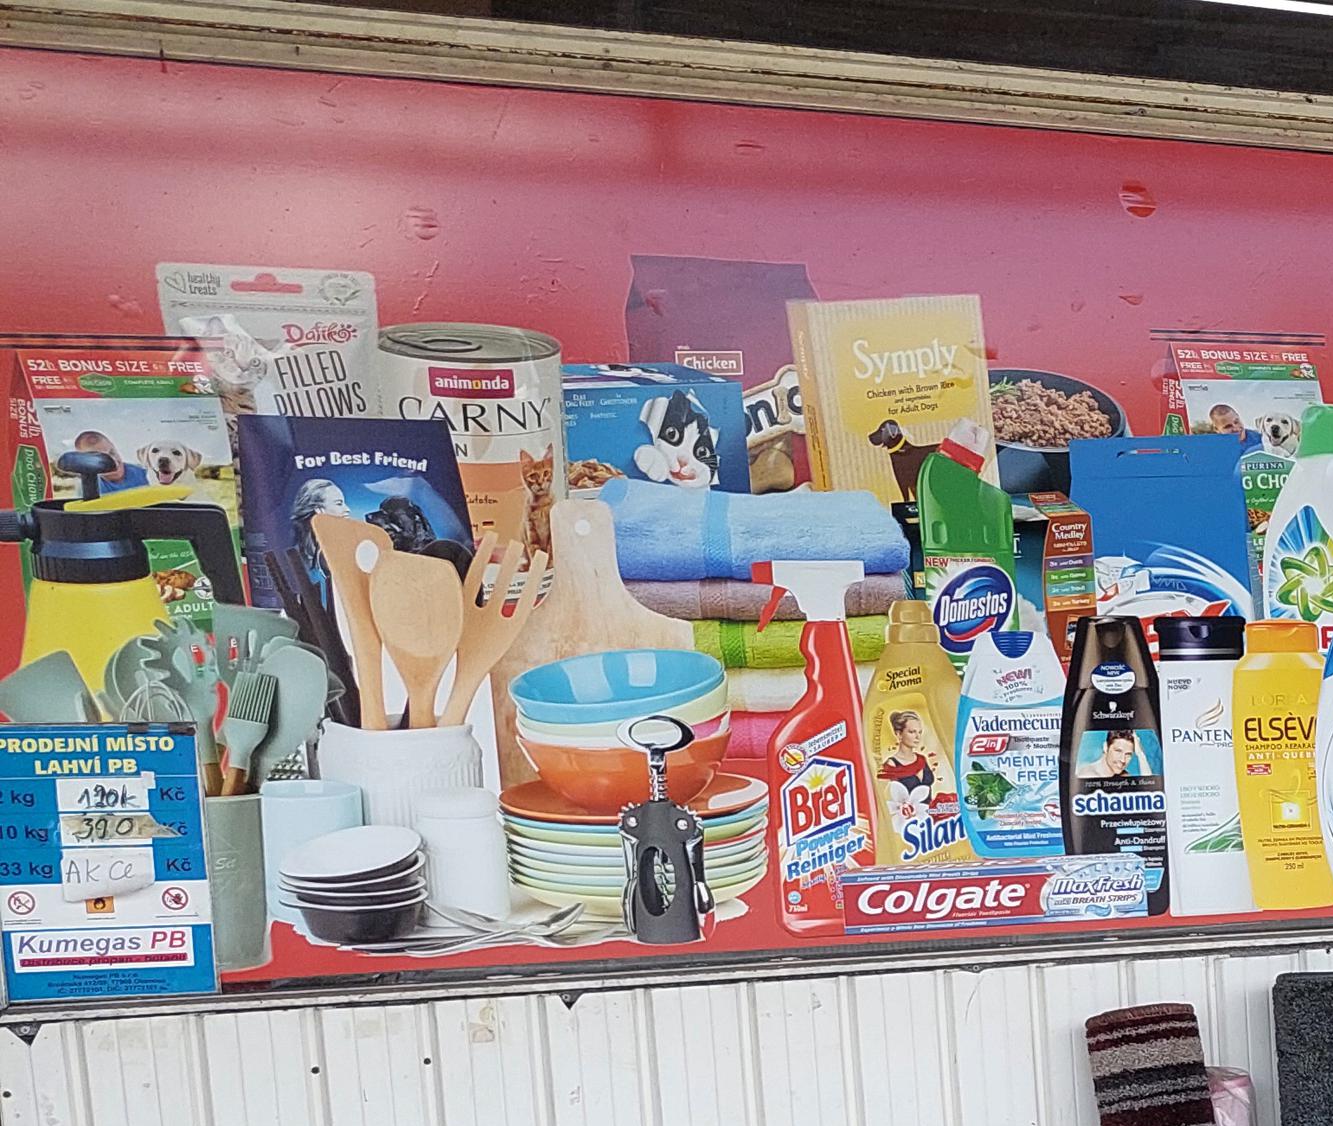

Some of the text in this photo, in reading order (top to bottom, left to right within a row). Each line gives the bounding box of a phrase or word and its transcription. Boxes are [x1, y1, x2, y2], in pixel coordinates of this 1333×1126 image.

[59, 360, 204, 373] BONUS SIZE FREE
[274, 350, 347, 390] FILLED
[683, 356, 738, 372] Chicken
[852, 337, 958, 385] Symply
[435, 370, 511, 391] animonda
[294, 451, 428, 473] For Best Friend
[1246, 461, 1284, 470] PURINA
[1051, 521, 1087, 534] Country
[1054, 530, 1085, 541] Medley
[939, 591, 1008, 626] Domestos
[886, 666, 921, 681] Special
[889, 675, 922, 691] Aroma
[106, 735, 175, 752] MÍSTO
[34, 756, 138, 775] LAHVÍ PB
[11, 789, 35, 808] kg
[160, 786, 186, 802] Kč
[788, 768, 848, 837] Bref
[1072, 790, 1166, 816] schauma
[25, 824, 49, 842] kg
[795, 822, 852, 857] Power
[902, 813, 966, 861] Silan
[166, 858, 192, 873] Kč
[786, 834, 866, 881] Reiniger
[29, 862, 53, 879] kg
[857, 878, 1027, 921] Colgate
[18, 930, 187, 956] Kumegas PB
